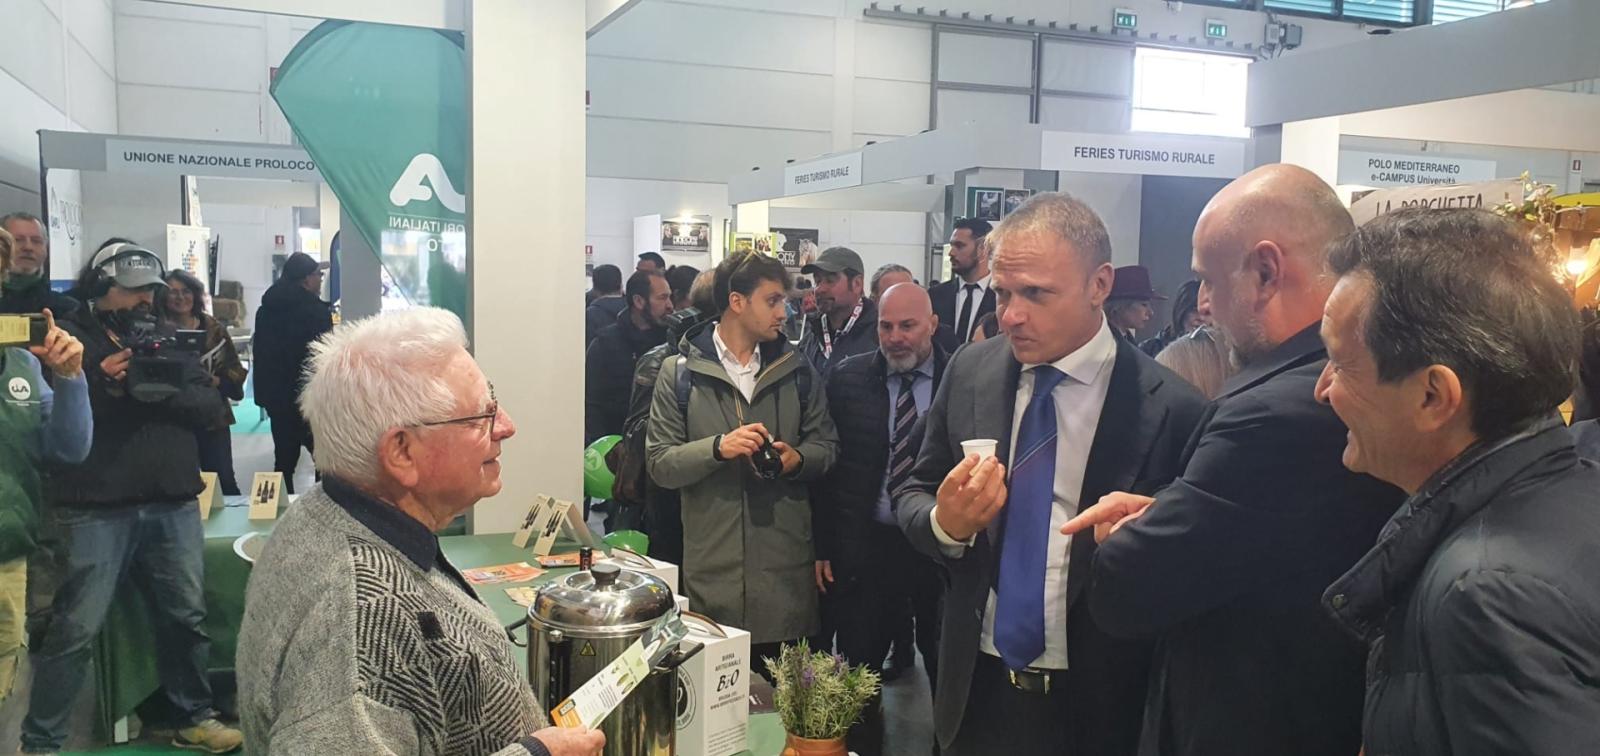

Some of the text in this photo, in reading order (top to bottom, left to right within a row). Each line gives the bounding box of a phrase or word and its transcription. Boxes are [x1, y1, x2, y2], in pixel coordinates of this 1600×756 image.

[123, 151, 315, 171] UNIONE NAZIONALE PROLOCO
[1074, 146, 1215, 165] FERIES TURISMO RURALE
[1368, 158, 1460, 174] POLO MEDITERRANEO
[1371, 172, 1415, 184] e-CAMPUS
